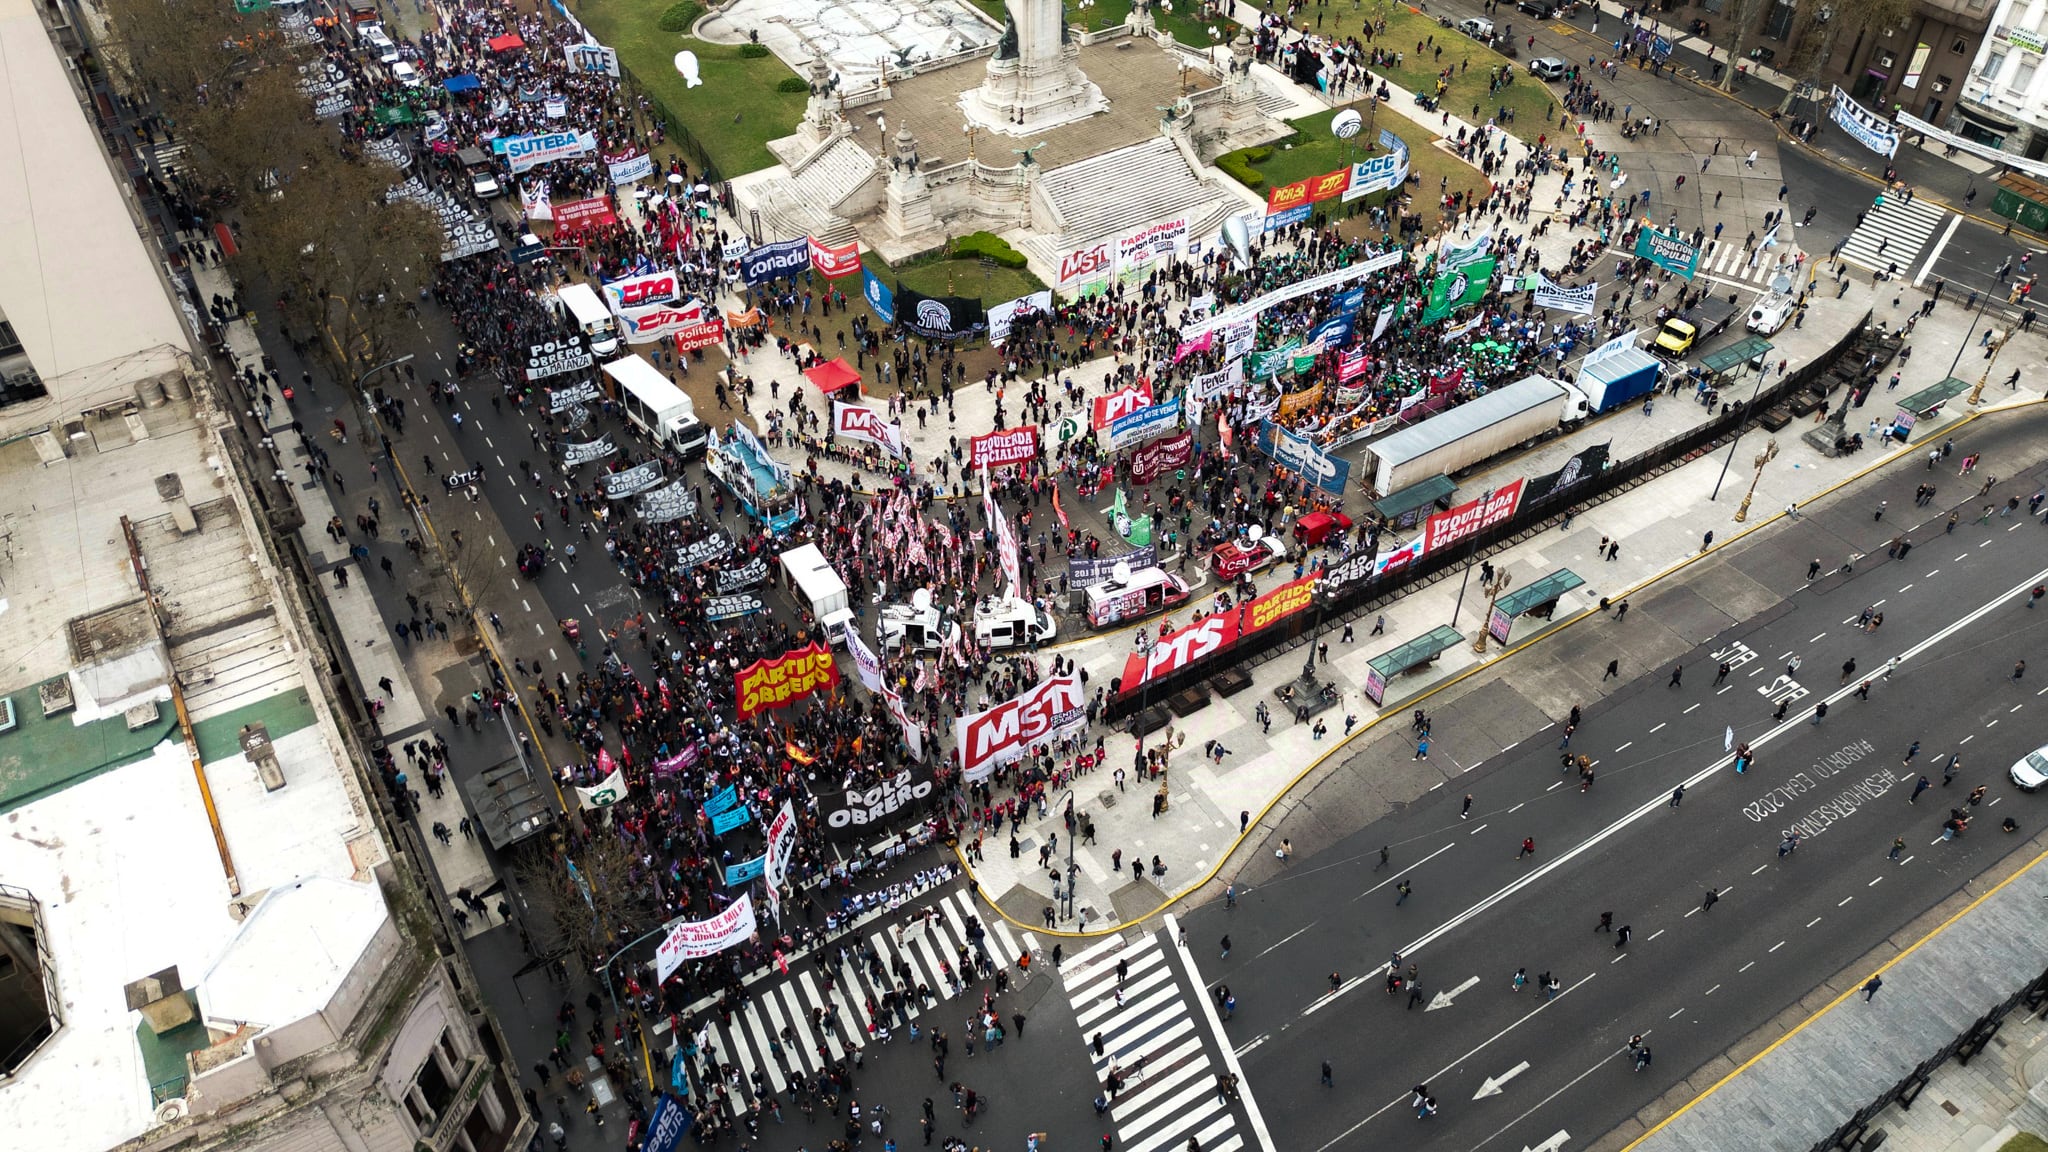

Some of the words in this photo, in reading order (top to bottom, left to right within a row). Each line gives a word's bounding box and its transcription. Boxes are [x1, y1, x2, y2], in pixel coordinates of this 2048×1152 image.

[2011, 31, 2041, 45] VENDE
[315, 100, 351, 115] OBRERO
[316, 94, 344, 106] POLO
[509, 133, 576, 157] SUTEBA
[613, 160, 650, 180] judiciales
[1357, 156, 1394, 177] CCC
[1319, 173, 1345, 192] PTP
[1122, 232, 1146, 247] PARO
[1161, 227, 1186, 240] lucha
[750, 249, 807, 278] conadu
[1060, 244, 1108, 282] MST
[622, 278, 674, 303] CTA
[638, 308, 700, 331] CTA
[917, 313, 952, 332] SUTNA
[530, 336, 580, 357] POLO
[682, 336, 719, 351] Obrera
[529, 346, 582, 367] OBRERO
[536, 366, 548, 377] LA
[550, 355, 590, 374] MATANZA
[551, 380, 590, 401] POLO
[1105, 389, 1151, 421] PTS
[1159, 404, 1177, 415] VENDE
[976, 432, 1033, 452] IZQUIERDA
[974, 445, 1034, 465] SOCIALISTA
[607, 471, 656, 493] OBRERO
[612, 467, 650, 485] POLO
[646, 482, 681, 500] POLO
[1434, 491, 1514, 537] IZQUIERDA
[676, 533, 720, 557] POLO
[1329, 555, 1367, 580] POLO
[705, 599, 762, 615] OBRERO
[709, 595, 752, 607] POLO
[1253, 580, 1315, 614] PARTIDO
[1254, 593, 1313, 627] OBRERO
[1142, 618, 1225, 684] PTS
[1710, 641, 1759, 671] BUS
[743, 653, 833, 696] PARTIDO
[743, 667, 830, 711] OBRERO
[1757, 674, 1810, 706] BUS
[967, 680, 1074, 768] MST
[1813, 738, 1875, 779] #ABORTO
[846, 768, 912, 807] POLO
[828, 781, 932, 828] OBRERO
[661, 942, 670, 954] NO
[711, 920, 723, 930] DE
[692, 921, 737, 942] JUBILADOS
[664, 1111, 684, 1149] SUR
